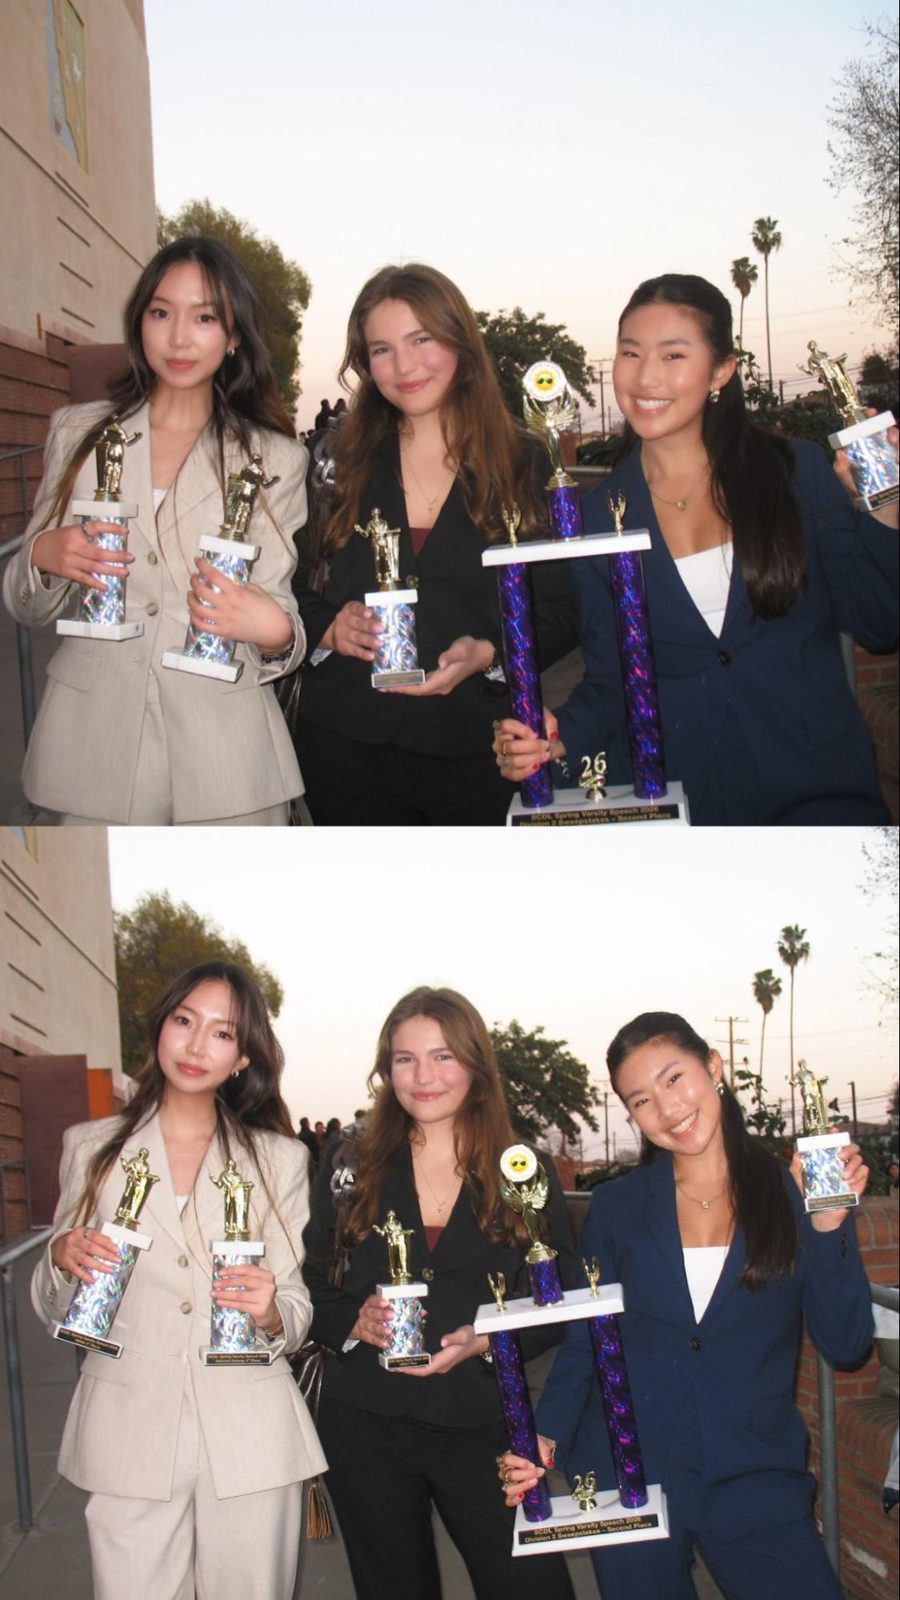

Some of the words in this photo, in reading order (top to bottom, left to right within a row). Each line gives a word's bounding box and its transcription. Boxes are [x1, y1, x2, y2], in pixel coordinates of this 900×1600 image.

[581, 751, 607, 777] 26
[555, 810, 580, 820] Spring
[581, 808, 608, 818] Varsity
[610, 806, 639, 816] Speech
[559, 815, 609, 825] Sweepstakes
[618, 812, 648, 822] Second
[649, 811, 672, 820] Place
[524, 1534, 551, 1543] Division
[557, 1528, 600, 1538] Sweepstakes
[607, 1524, 632, 1533] Second
[633, 1521, 653, 1530] Place
[554, 1525, 576, 1533] Spring
[576, 1522, 599, 1530] Varsity
[600, 1518, 625, 1527] Speech
